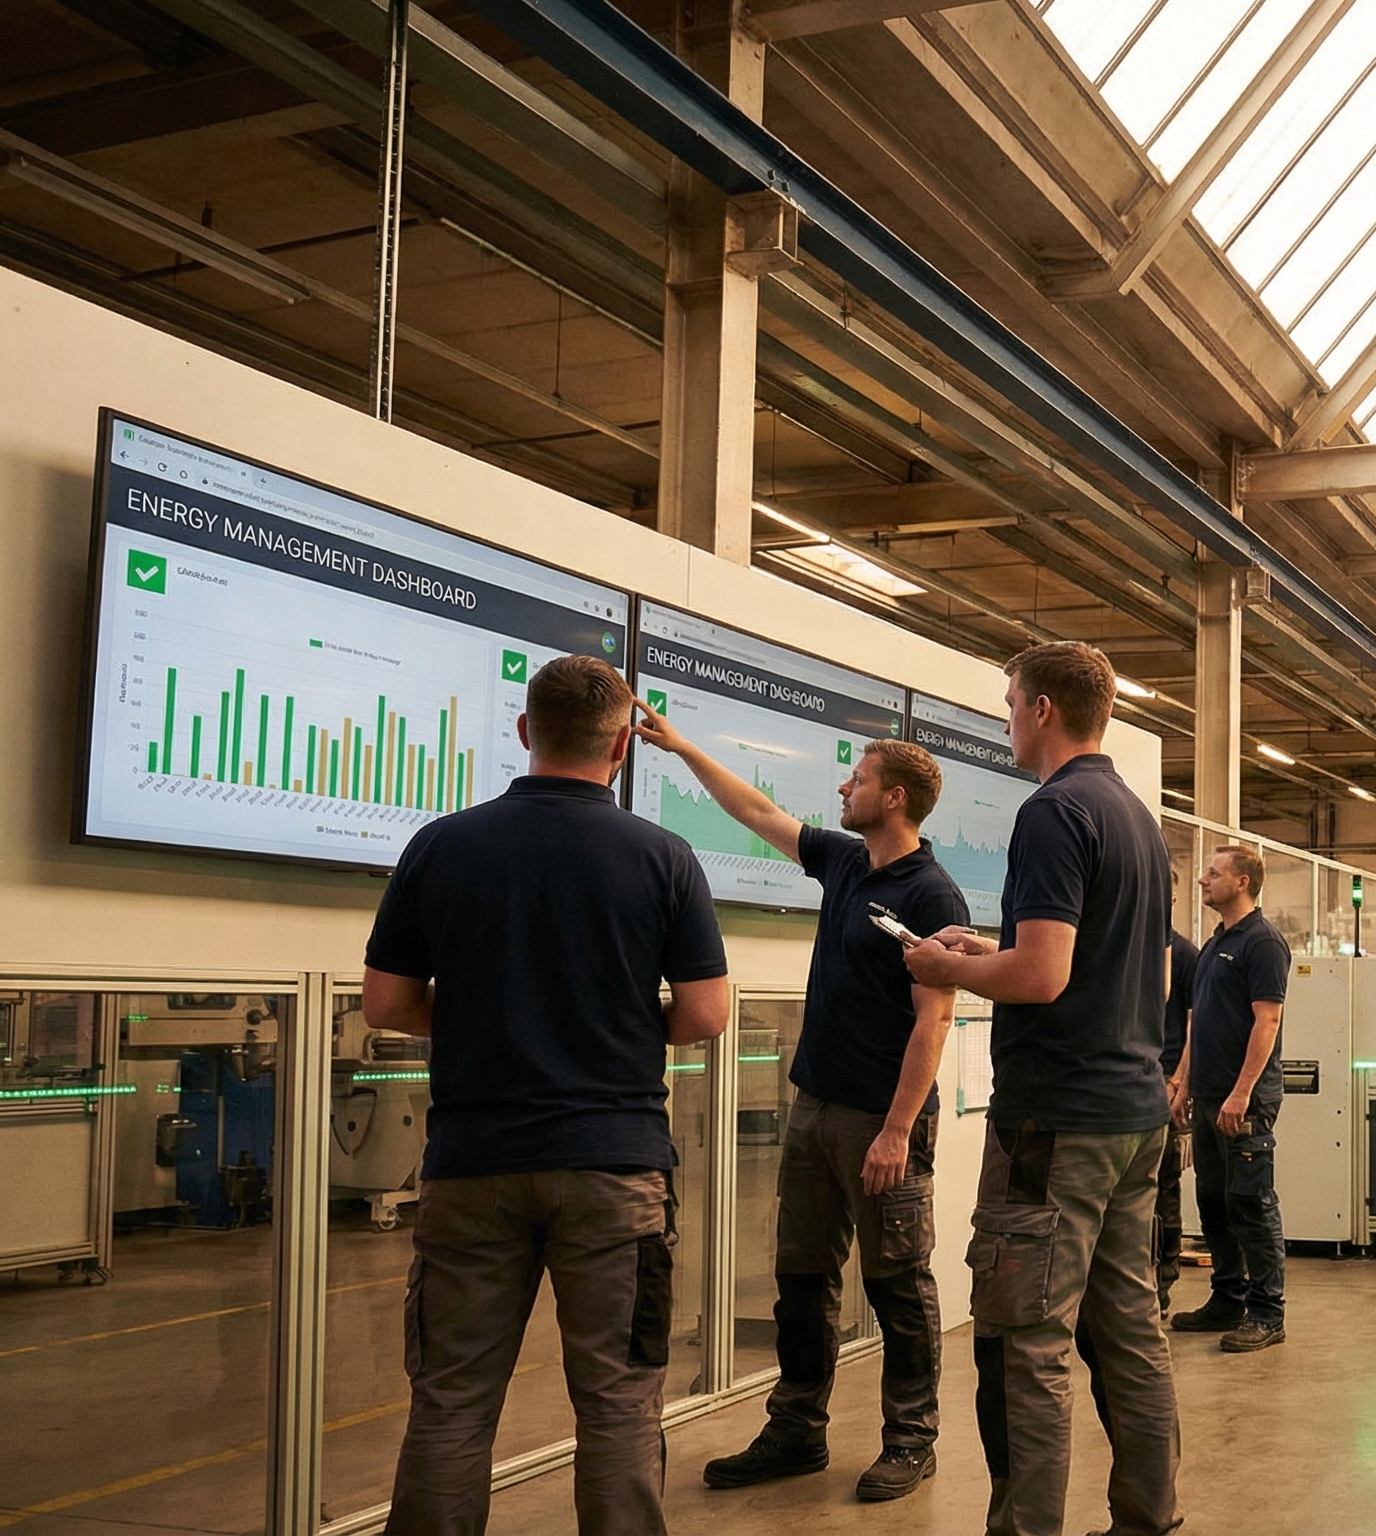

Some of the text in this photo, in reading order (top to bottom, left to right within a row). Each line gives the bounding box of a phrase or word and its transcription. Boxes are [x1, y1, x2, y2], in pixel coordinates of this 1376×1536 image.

[128, 488, 218, 533] ENERGY
[223, 517, 368, 578] MANAGEMENT
[373, 562, 477, 610] DASHBOARD
[647, 646, 694, 673] ENERGY
